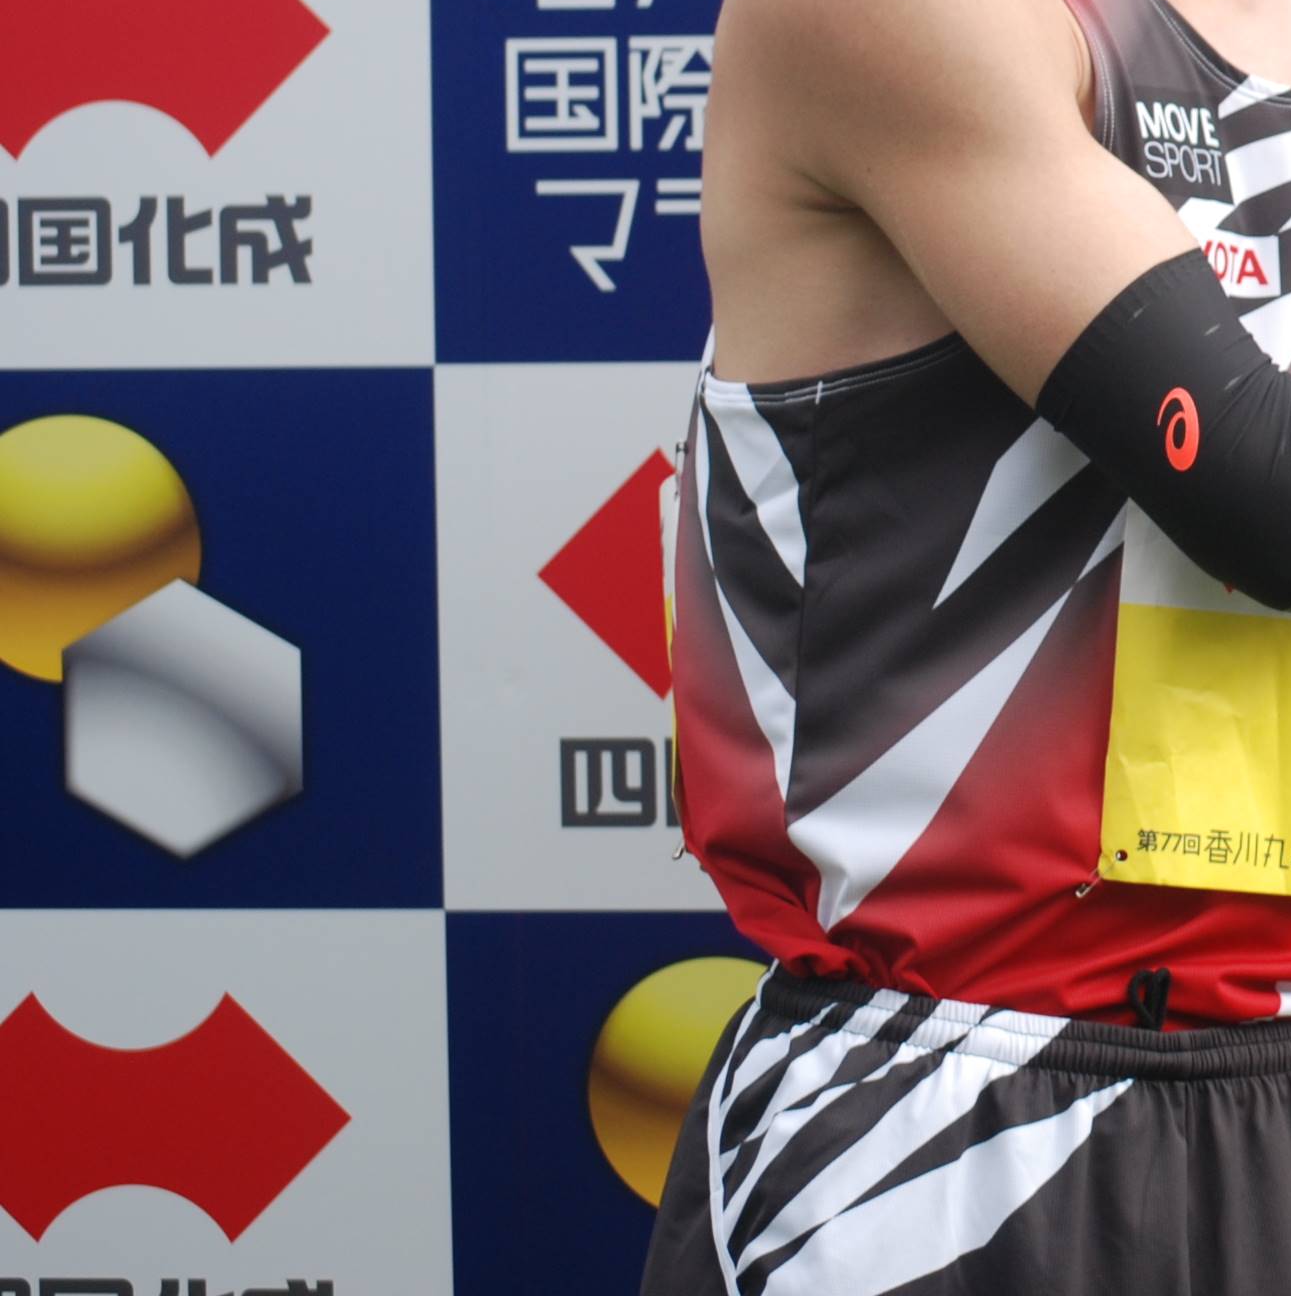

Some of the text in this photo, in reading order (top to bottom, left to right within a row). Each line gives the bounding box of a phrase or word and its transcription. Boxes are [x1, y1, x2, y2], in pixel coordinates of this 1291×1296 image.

[1136, 101, 1220, 148] MOVE
[1144, 141, 1222, 186] SPORT
[0, 195, 313, 288] 国化成
[1203, 240, 1268, 286] OTA
[560, 737, 685, 829] 四
